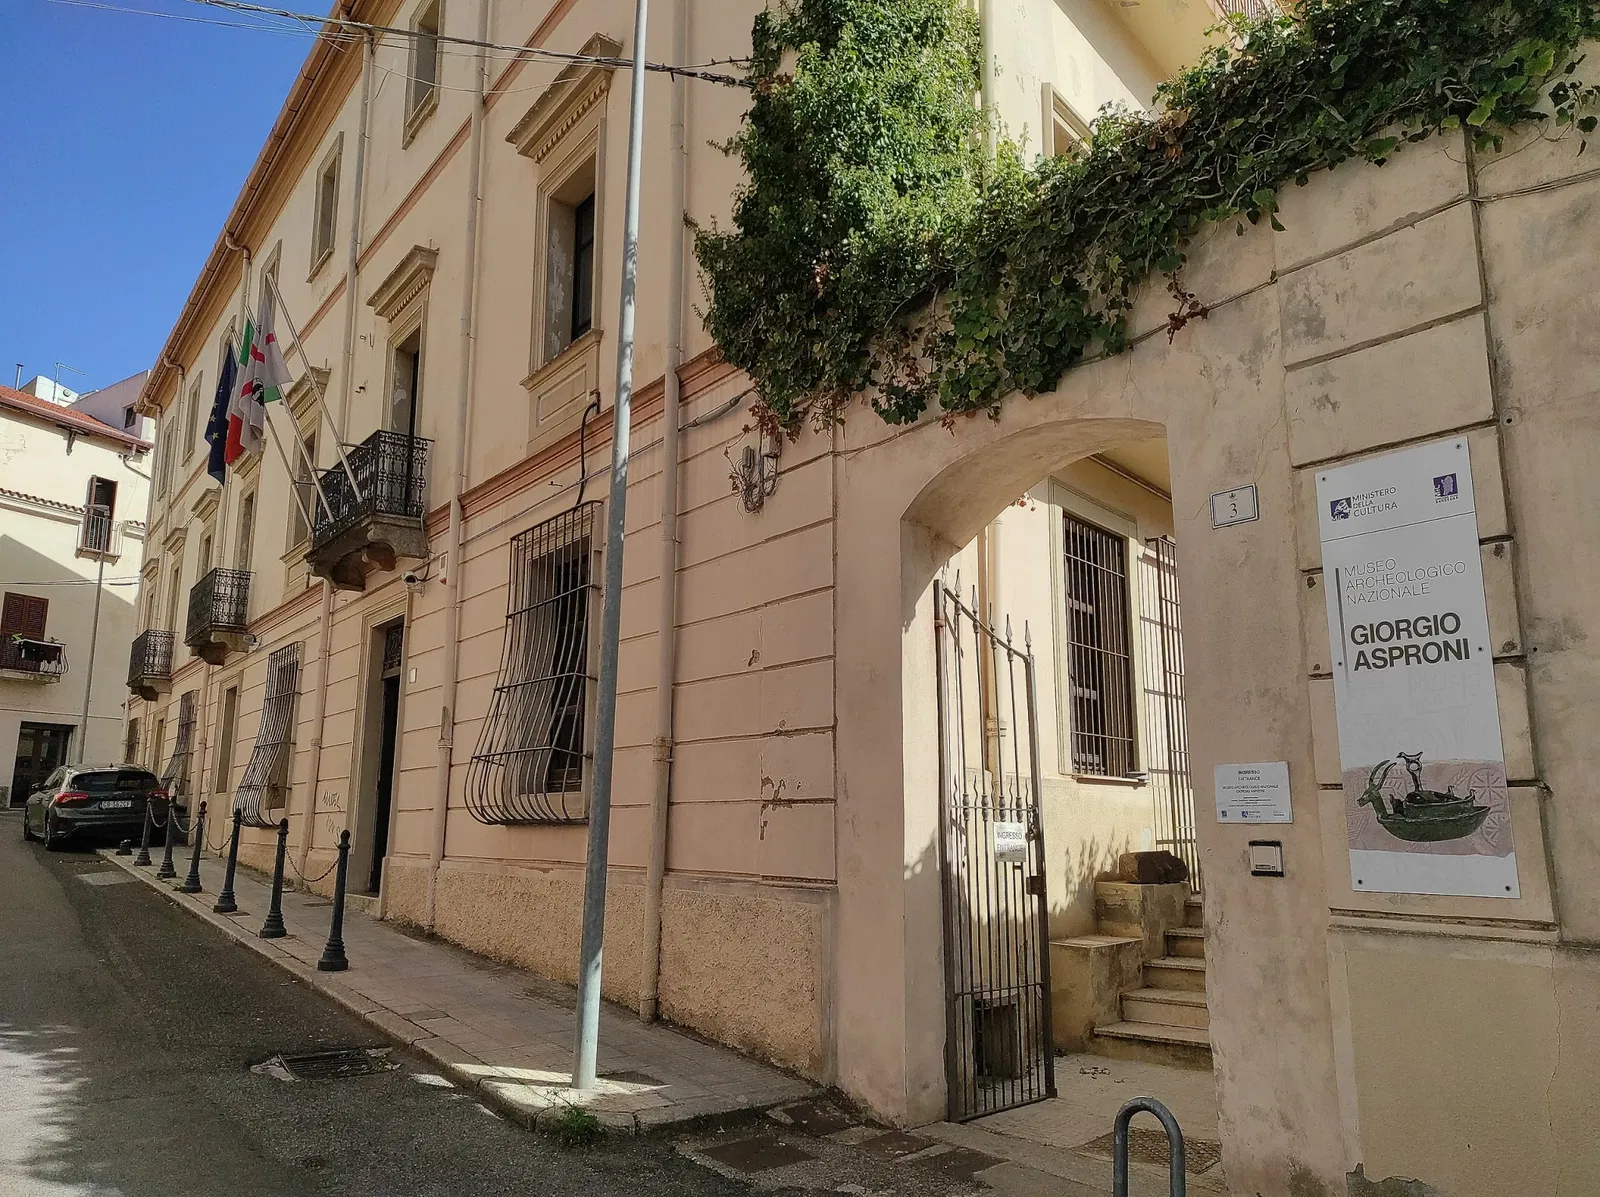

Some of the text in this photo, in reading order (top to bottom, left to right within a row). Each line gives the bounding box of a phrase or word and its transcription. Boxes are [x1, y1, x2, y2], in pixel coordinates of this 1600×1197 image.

[1352, 487, 1397, 502] MINISTERO
[1229, 503, 1238, 518] 3
[1353, 499, 1374, 509] DELLA
[1353, 501, 1398, 517] CULTURA
[1344, 558, 1397, 578] MUSEO
[1345, 561, 1466, 592] ARCHEOLOGICO
[1347, 582, 1431, 605] NAZIONALE
[1350, 612, 1461, 646] GIORGIO
[1353, 638, 1470, 672] ASPRONI
[996, 831, 1023, 840] INGRESSO
[996, 843, 1024, 853] ENTRANCE
